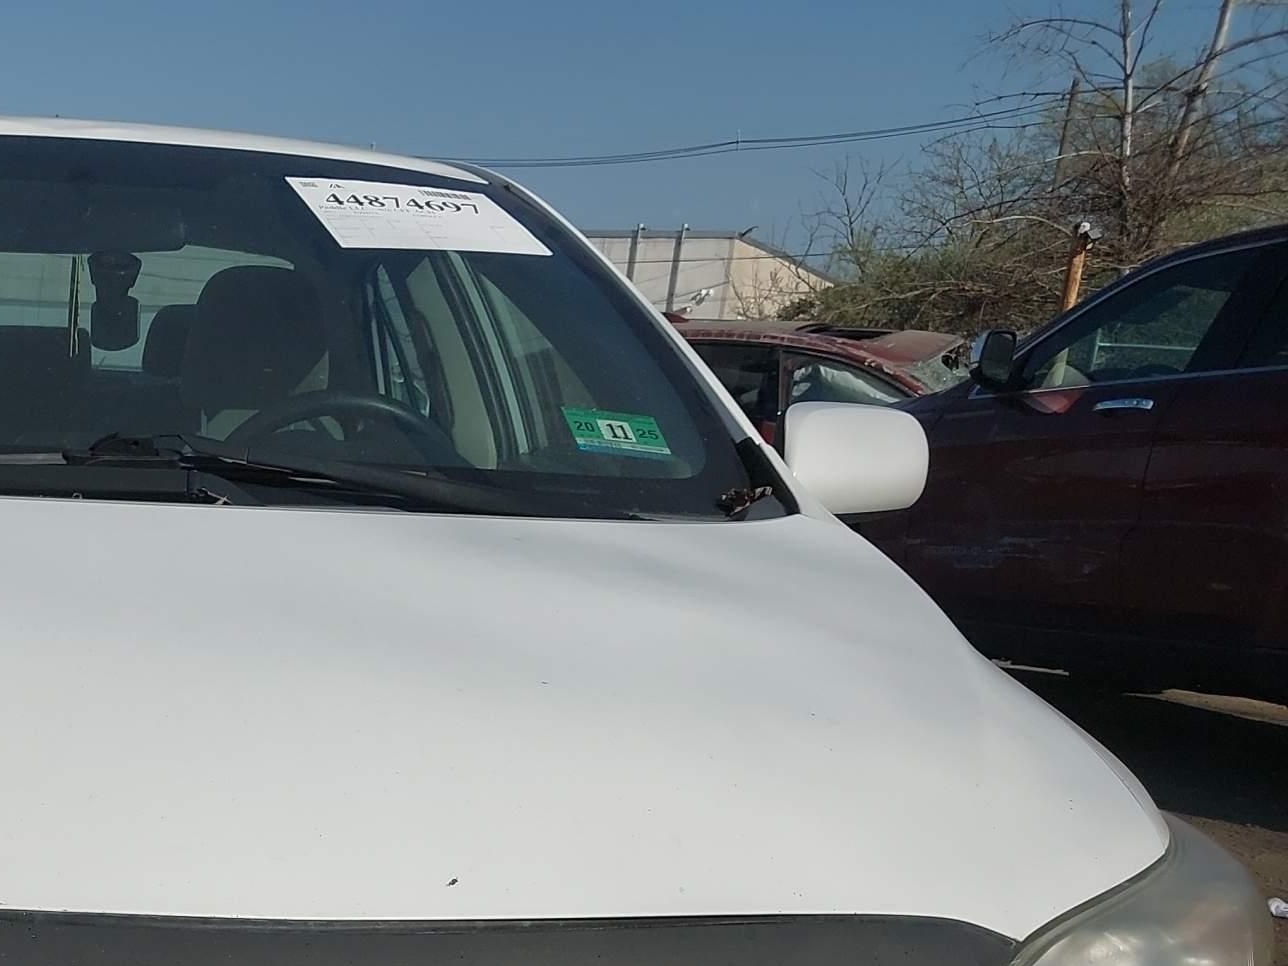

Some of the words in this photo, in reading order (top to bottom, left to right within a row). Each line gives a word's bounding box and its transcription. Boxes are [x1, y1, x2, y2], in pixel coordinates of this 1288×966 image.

[326, 193, 479, 215] 44874697
[574, 420, 595, 433] 20
[606, 423, 633, 441] 11
[636, 428, 659, 440] 25
